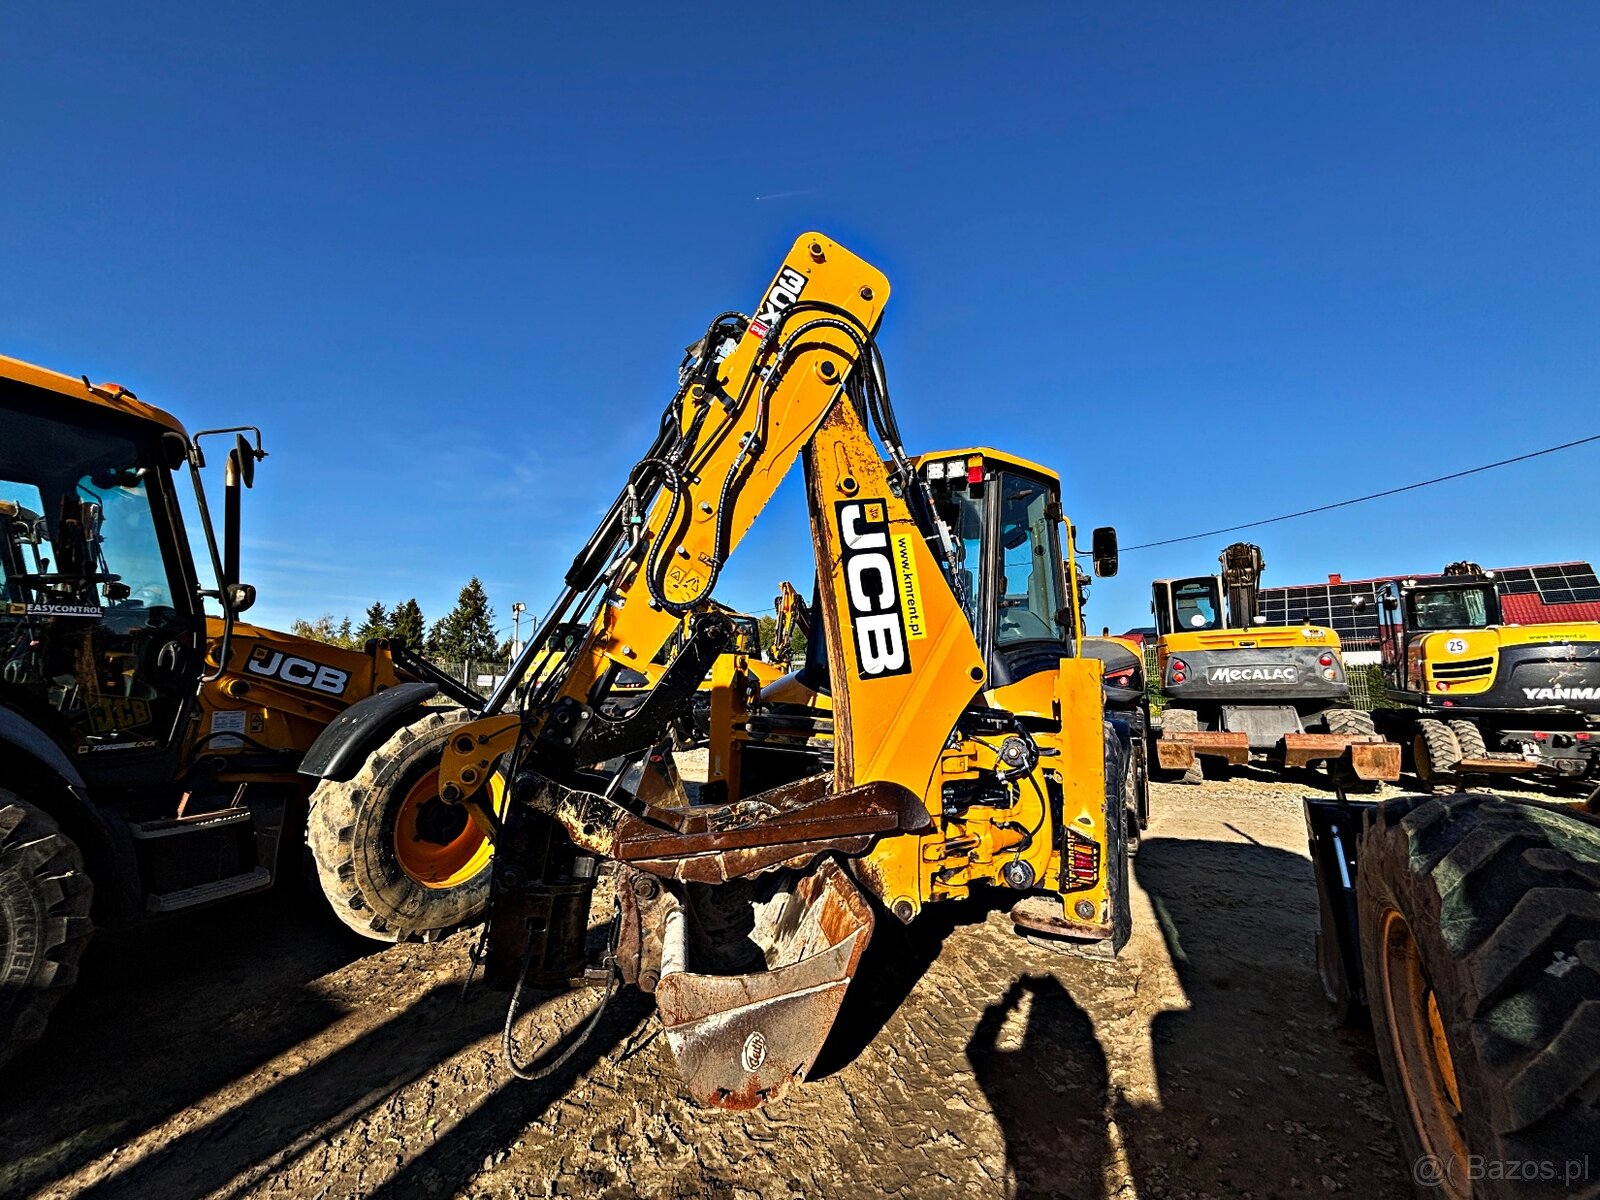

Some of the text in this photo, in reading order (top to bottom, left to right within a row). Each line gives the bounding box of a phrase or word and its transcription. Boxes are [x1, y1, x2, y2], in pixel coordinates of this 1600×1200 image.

[757, 269, 805, 327] 3CX
[751, 325, 767, 336] PR
[840, 504, 905, 675] JCB
[898, 537, 923, 636] www.kmrent.pl
[27, 603, 103, 614] EASYCONTROL
[1449, 640, 1463, 652] 25
[248, 652, 348, 694] JCB
[96, 698, 149, 731] JCB
